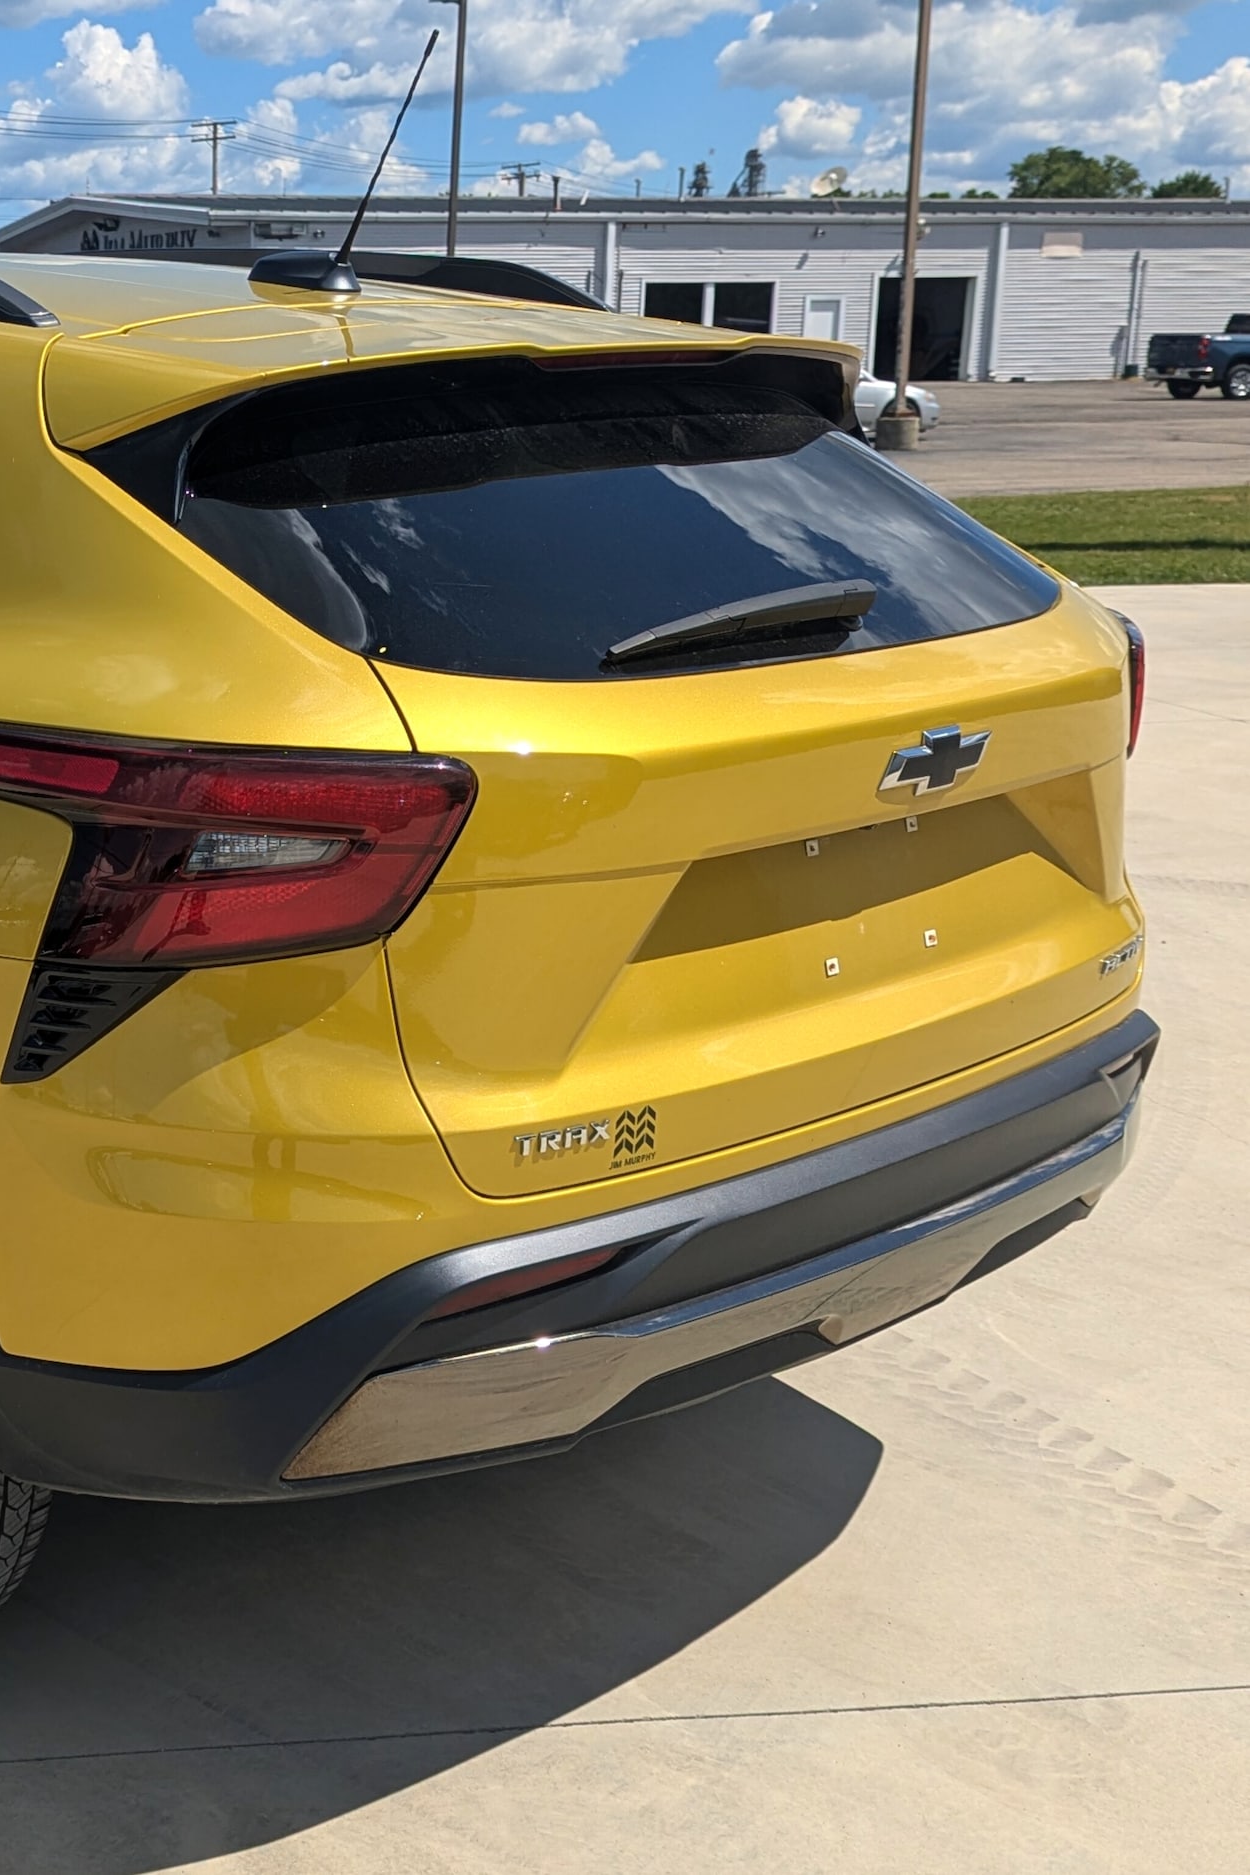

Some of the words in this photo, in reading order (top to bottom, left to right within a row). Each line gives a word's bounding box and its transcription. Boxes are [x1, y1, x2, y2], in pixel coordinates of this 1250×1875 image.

[514, 1119, 610, 1156] TRAX
[609, 1160, 623, 1170] JIM
[624, 1152, 656, 1166] MURPHY
